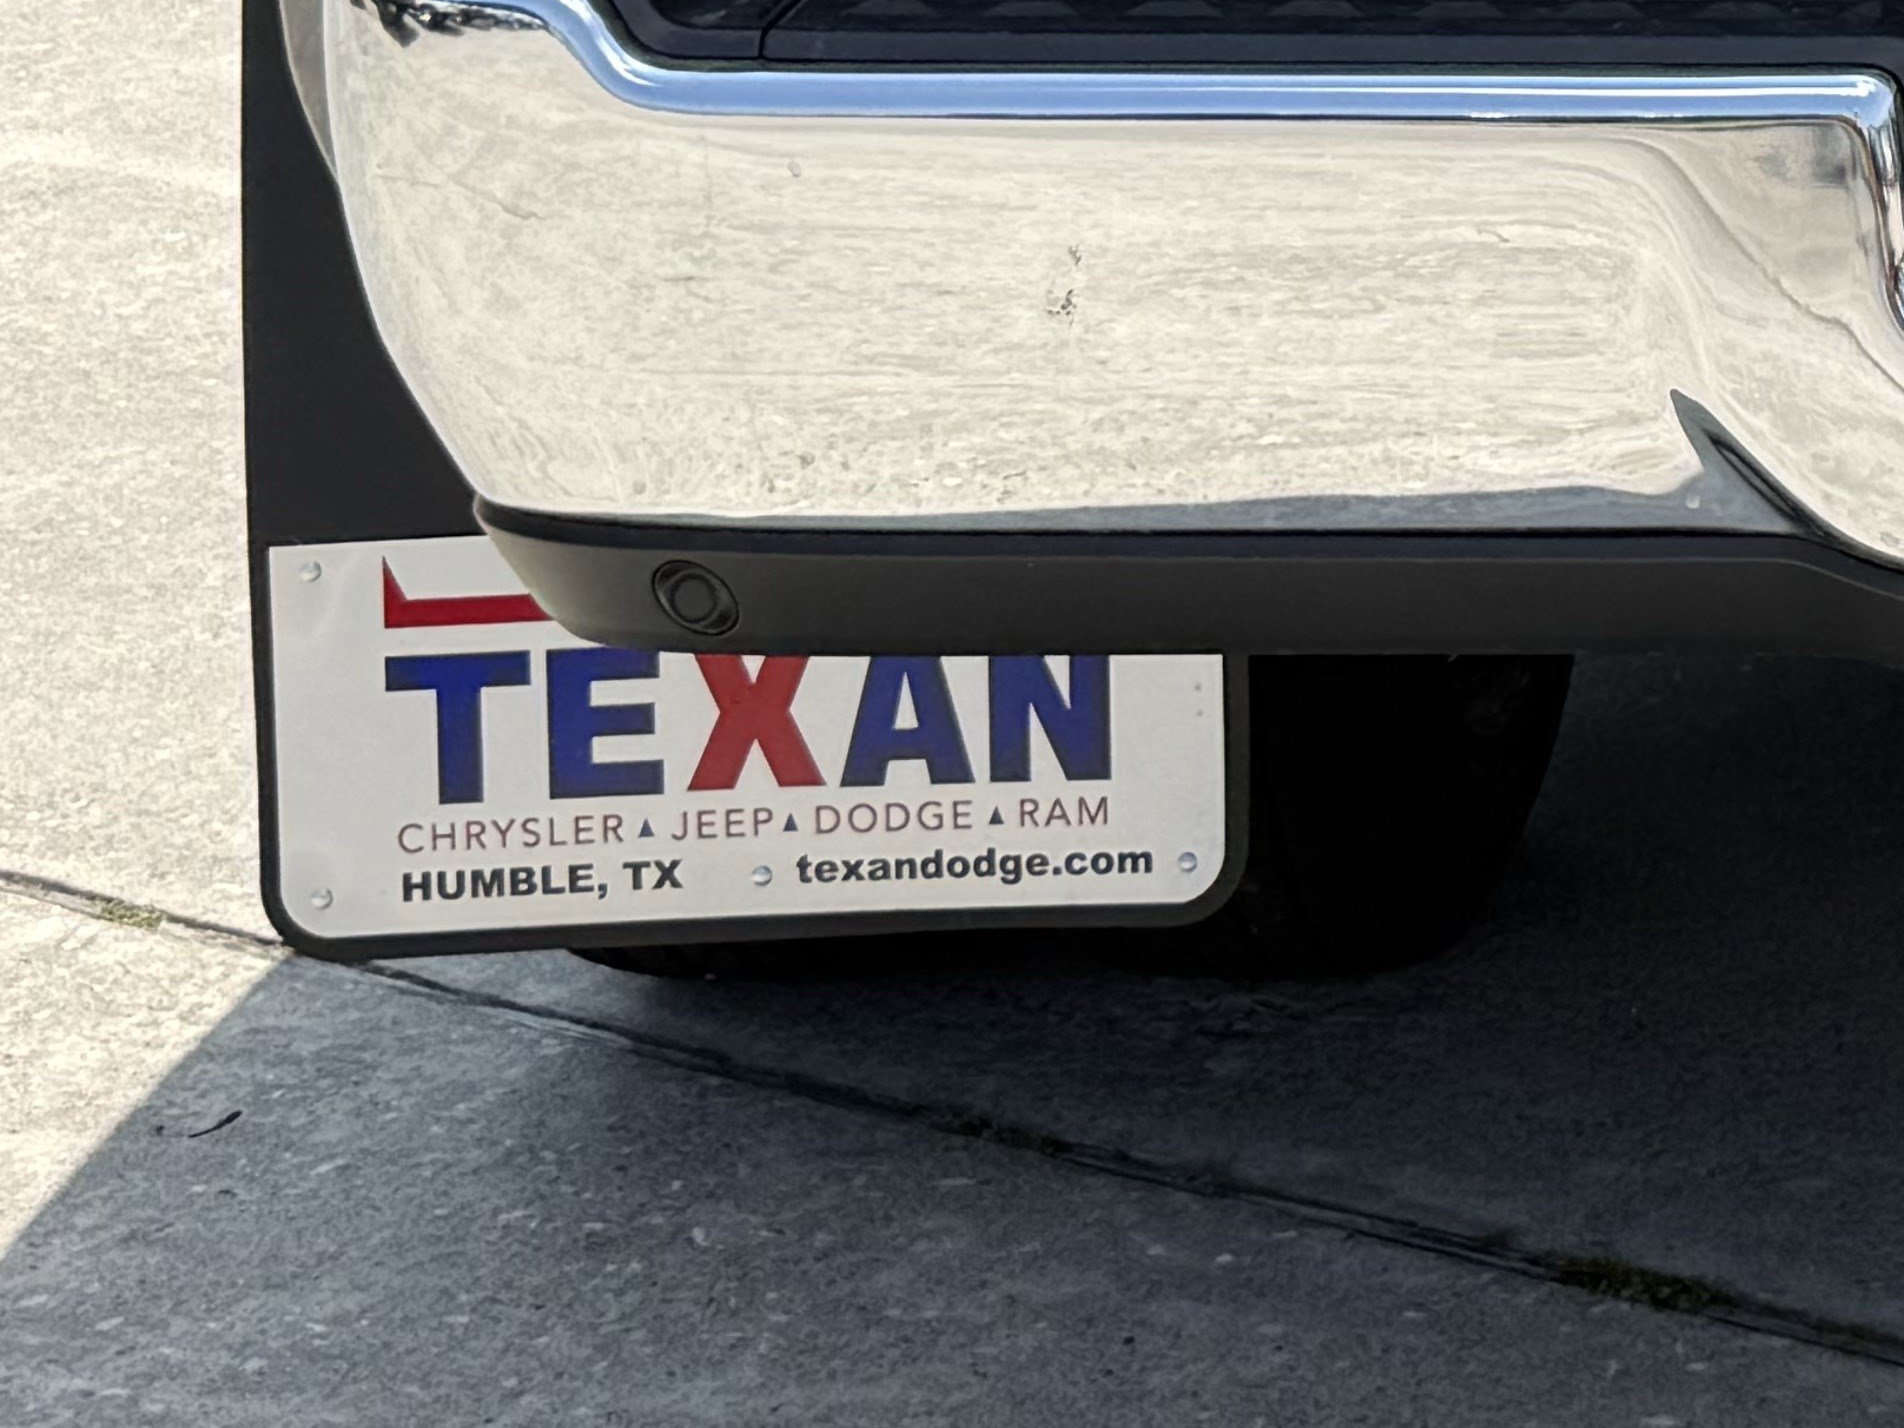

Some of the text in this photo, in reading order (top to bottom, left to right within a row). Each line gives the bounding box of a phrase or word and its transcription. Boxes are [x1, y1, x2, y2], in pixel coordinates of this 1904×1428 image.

[385, 646, 1112, 805] TEXAN
[397, 795, 1109, 855] CHRYSLER JEEP DODGE RAM
[402, 847, 1155, 902] HUMBLE, TX texandodge.com
